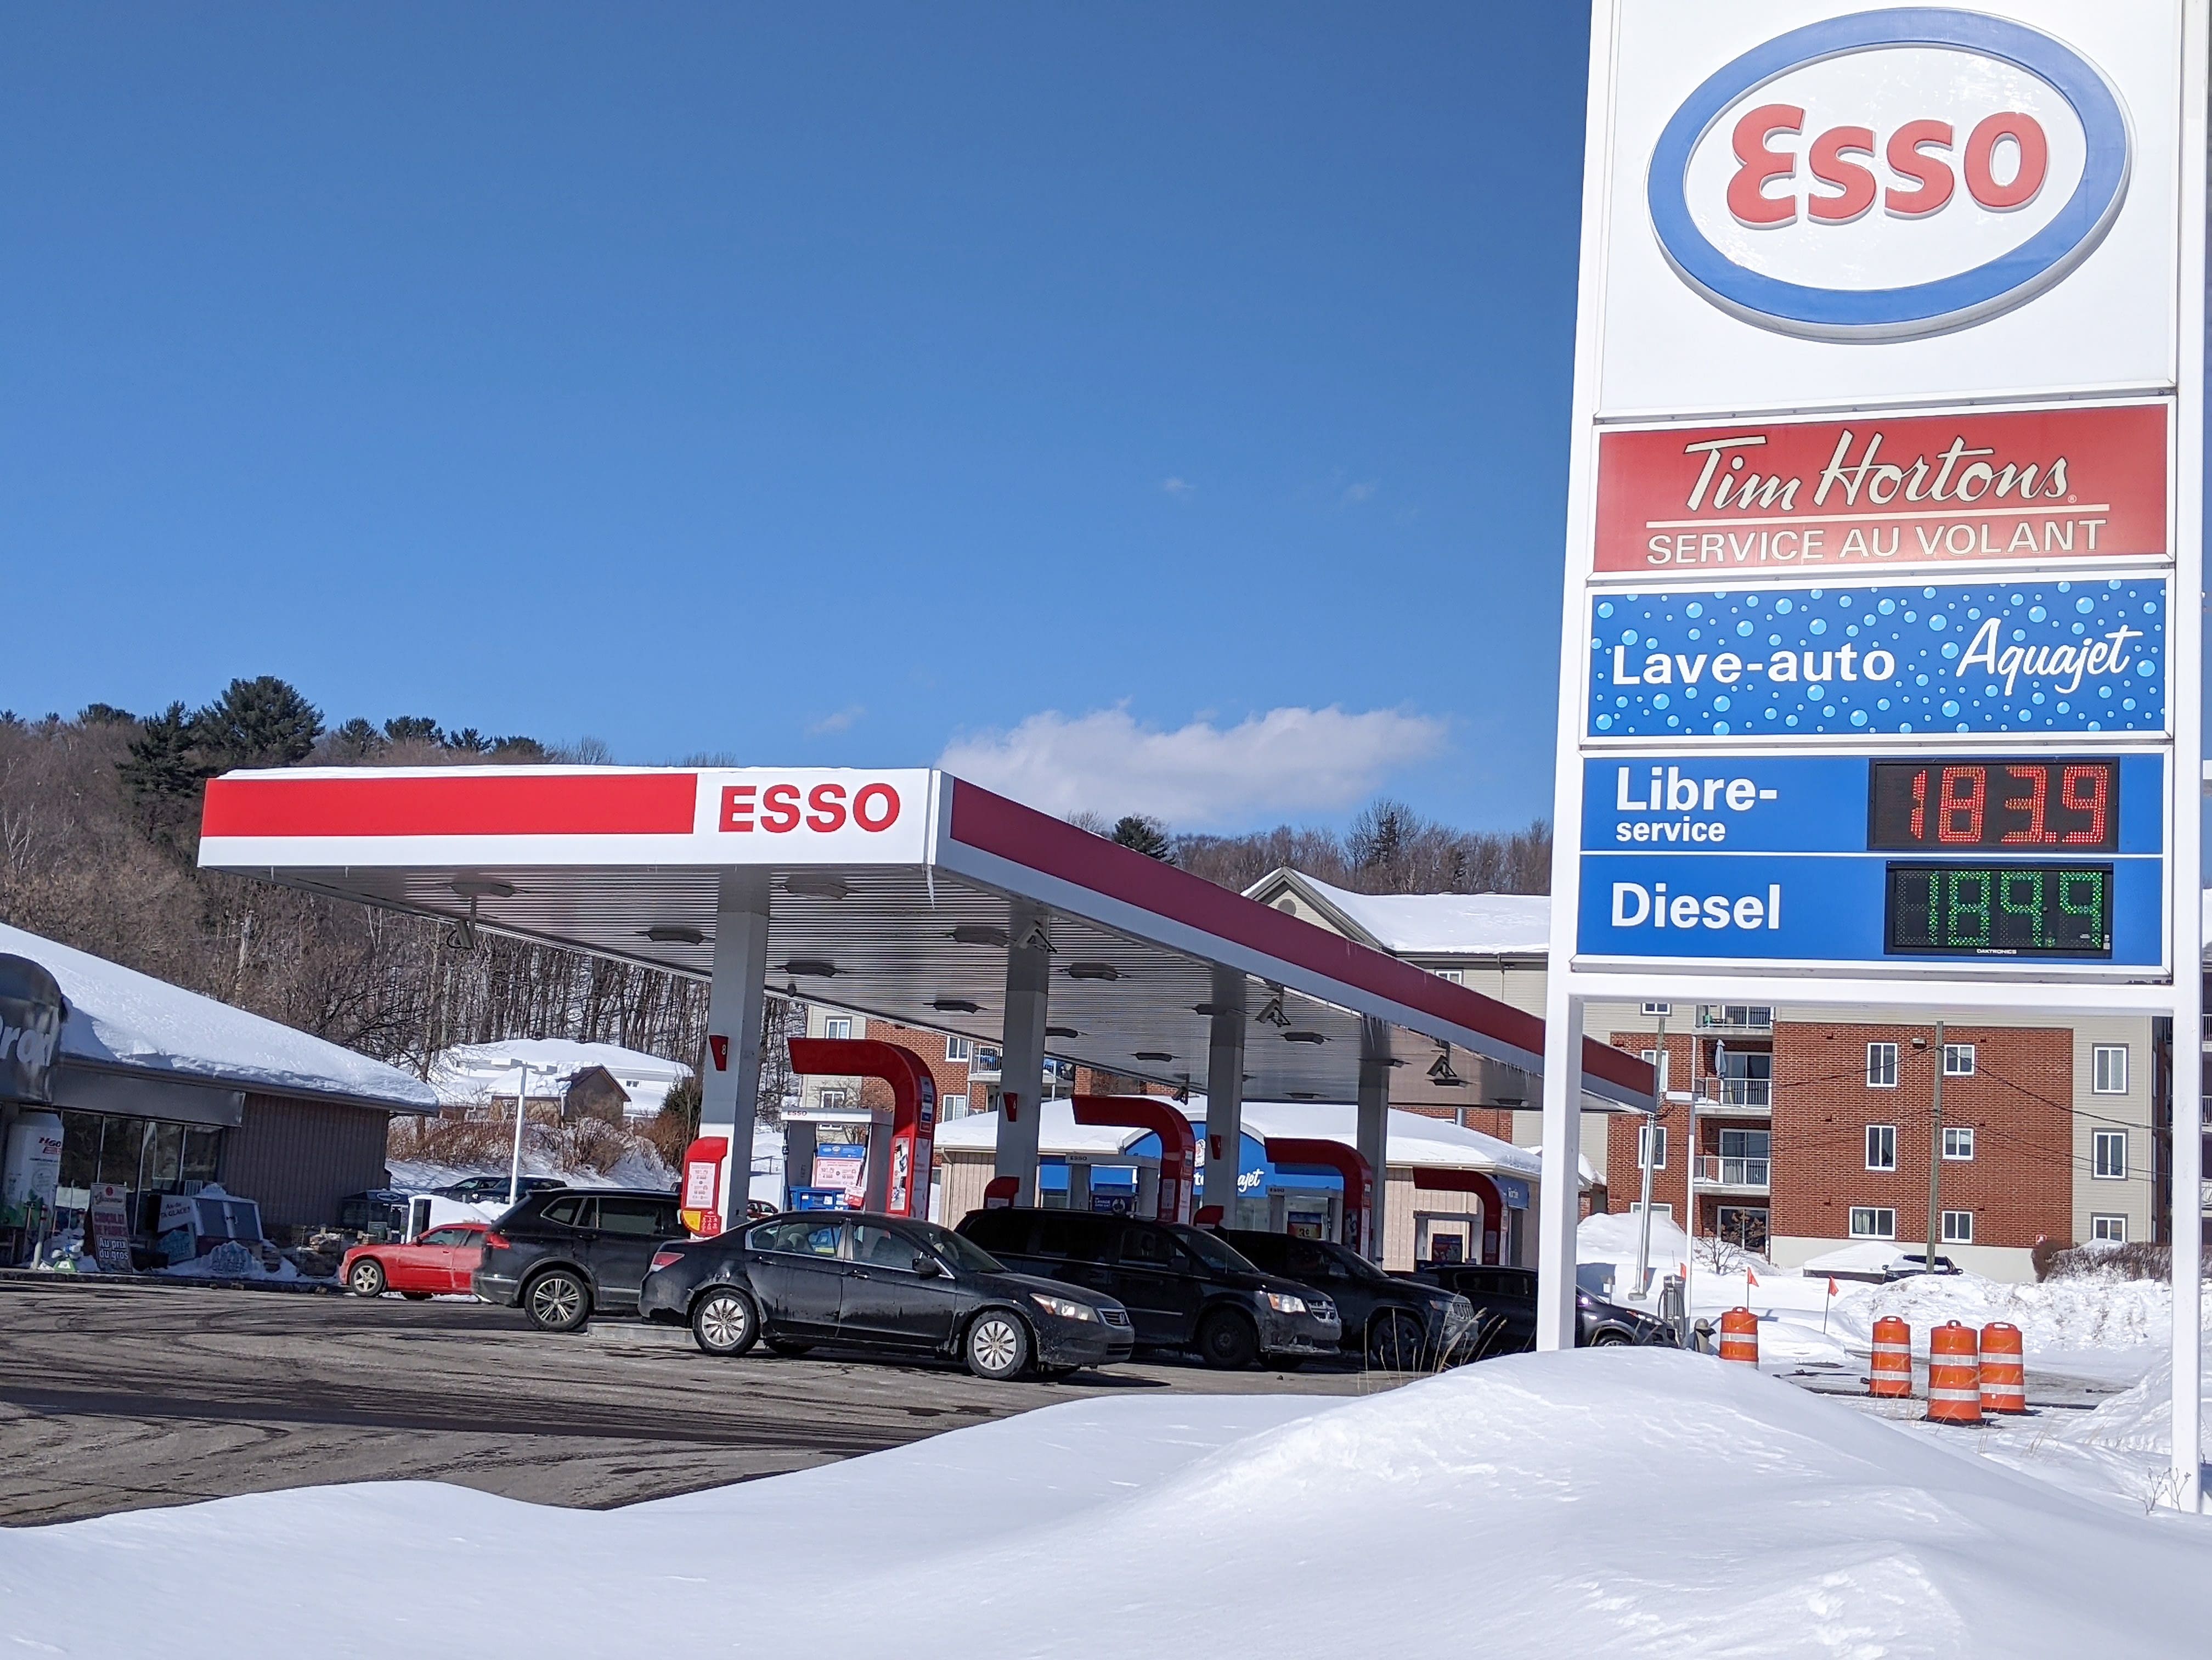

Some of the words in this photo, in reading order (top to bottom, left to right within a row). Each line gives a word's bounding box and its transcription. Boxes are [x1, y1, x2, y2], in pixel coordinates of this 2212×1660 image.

[1684, 435, 1800, 511] Tim
[1813, 429, 2070, 507] Hortons
[1646, 528, 1825, 565] SERVICE
[1838, 525, 1900, 560] AU
[1915, 519, 2108, 556] VOLANT
[1612, 643, 1895, 686] Lave-auto
[1956, 617, 2143, 696] Aquajet
[719, 783, 900, 833] ESSO
[1617, 766, 1778, 811] Libre-
[1910, 766, 2108, 843] 183.9
[1616, 815, 1726, 842] service
[1611, 882, 1781, 929] Diesel
[721, 1044, 726, 1055] 8
[99, 1237, 110, 1248] Au
[111, 1239, 126, 1250] prix
[99, 1248, 110, 1258] du
[111, 1252, 129, 1261] gros
